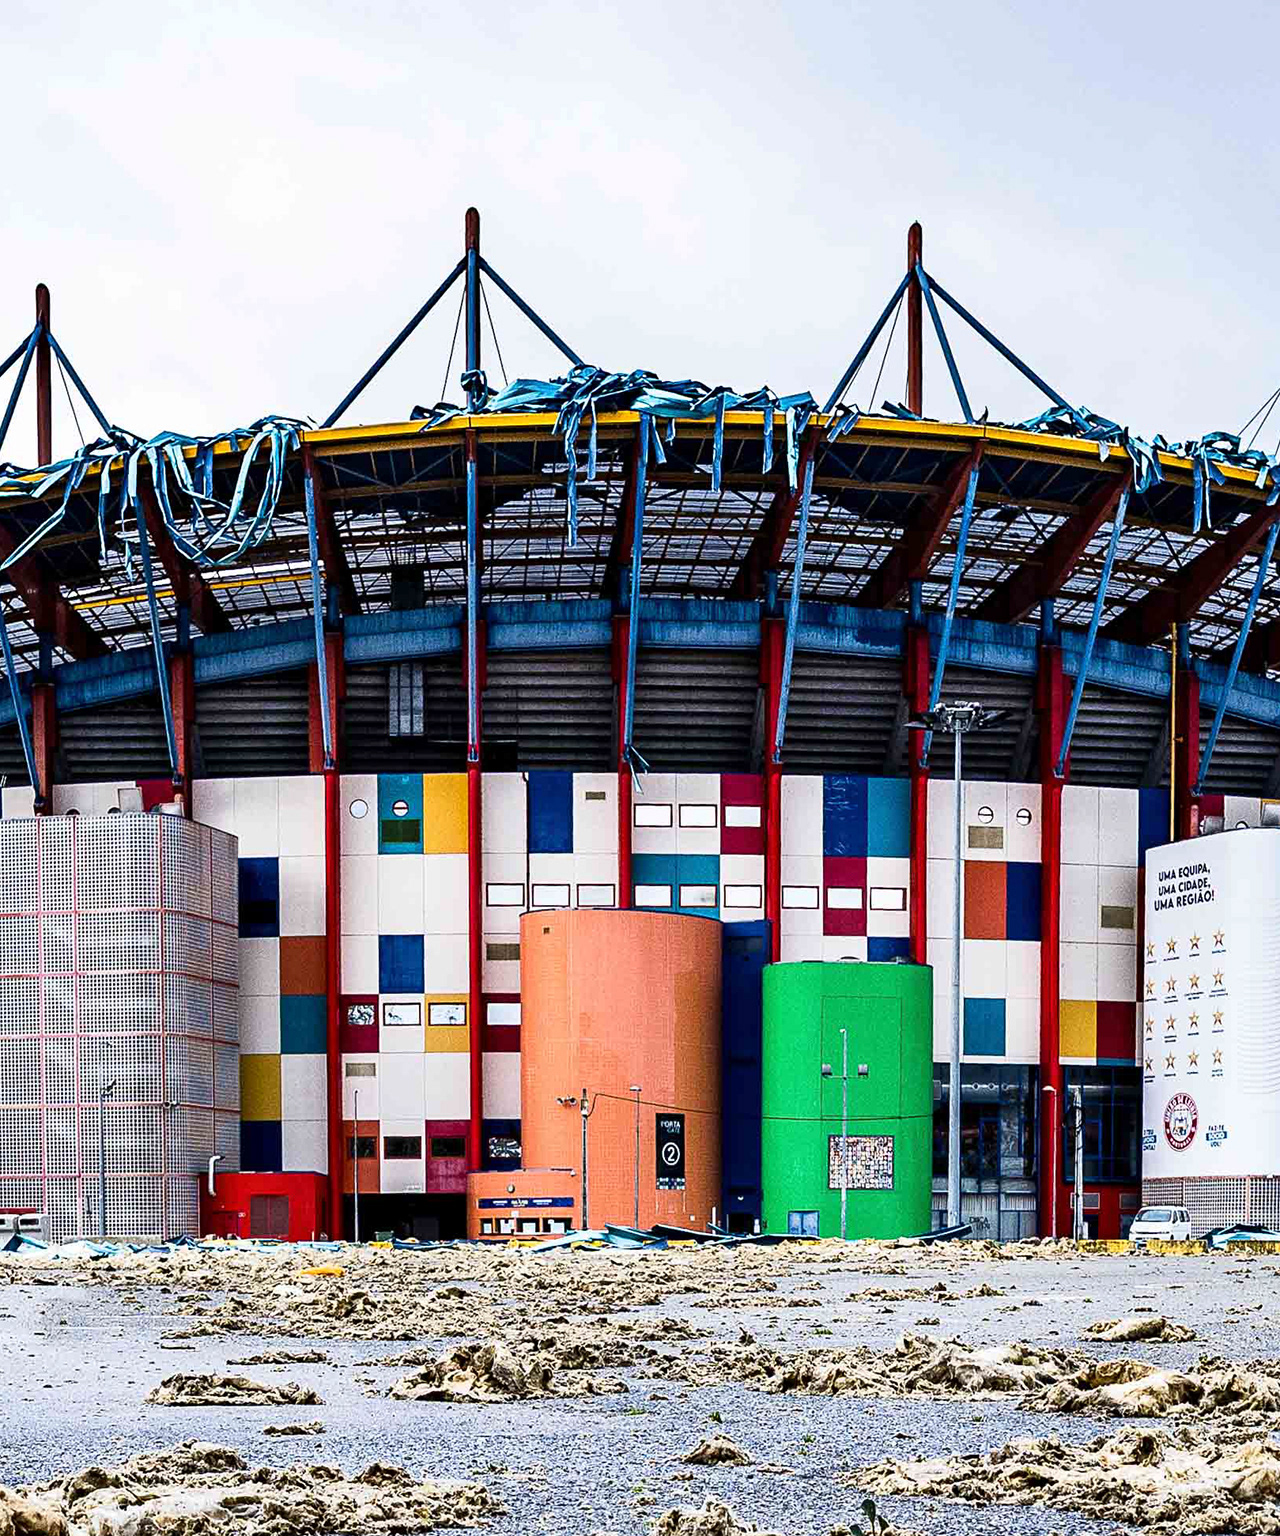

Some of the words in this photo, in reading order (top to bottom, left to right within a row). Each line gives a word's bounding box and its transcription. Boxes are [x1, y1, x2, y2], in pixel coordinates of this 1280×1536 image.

[1158, 869, 1176, 882] UMA
[1178, 863, 1211, 878] EQUIPA,
[1158, 884, 1176, 896] UMA
[1178, 877, 1211, 893] CIDADE,
[1154, 899, 1174, 911] UMA
[1176, 889, 1215, 907] REGIÃO!
[667, 1146, 675, 1162] 2
